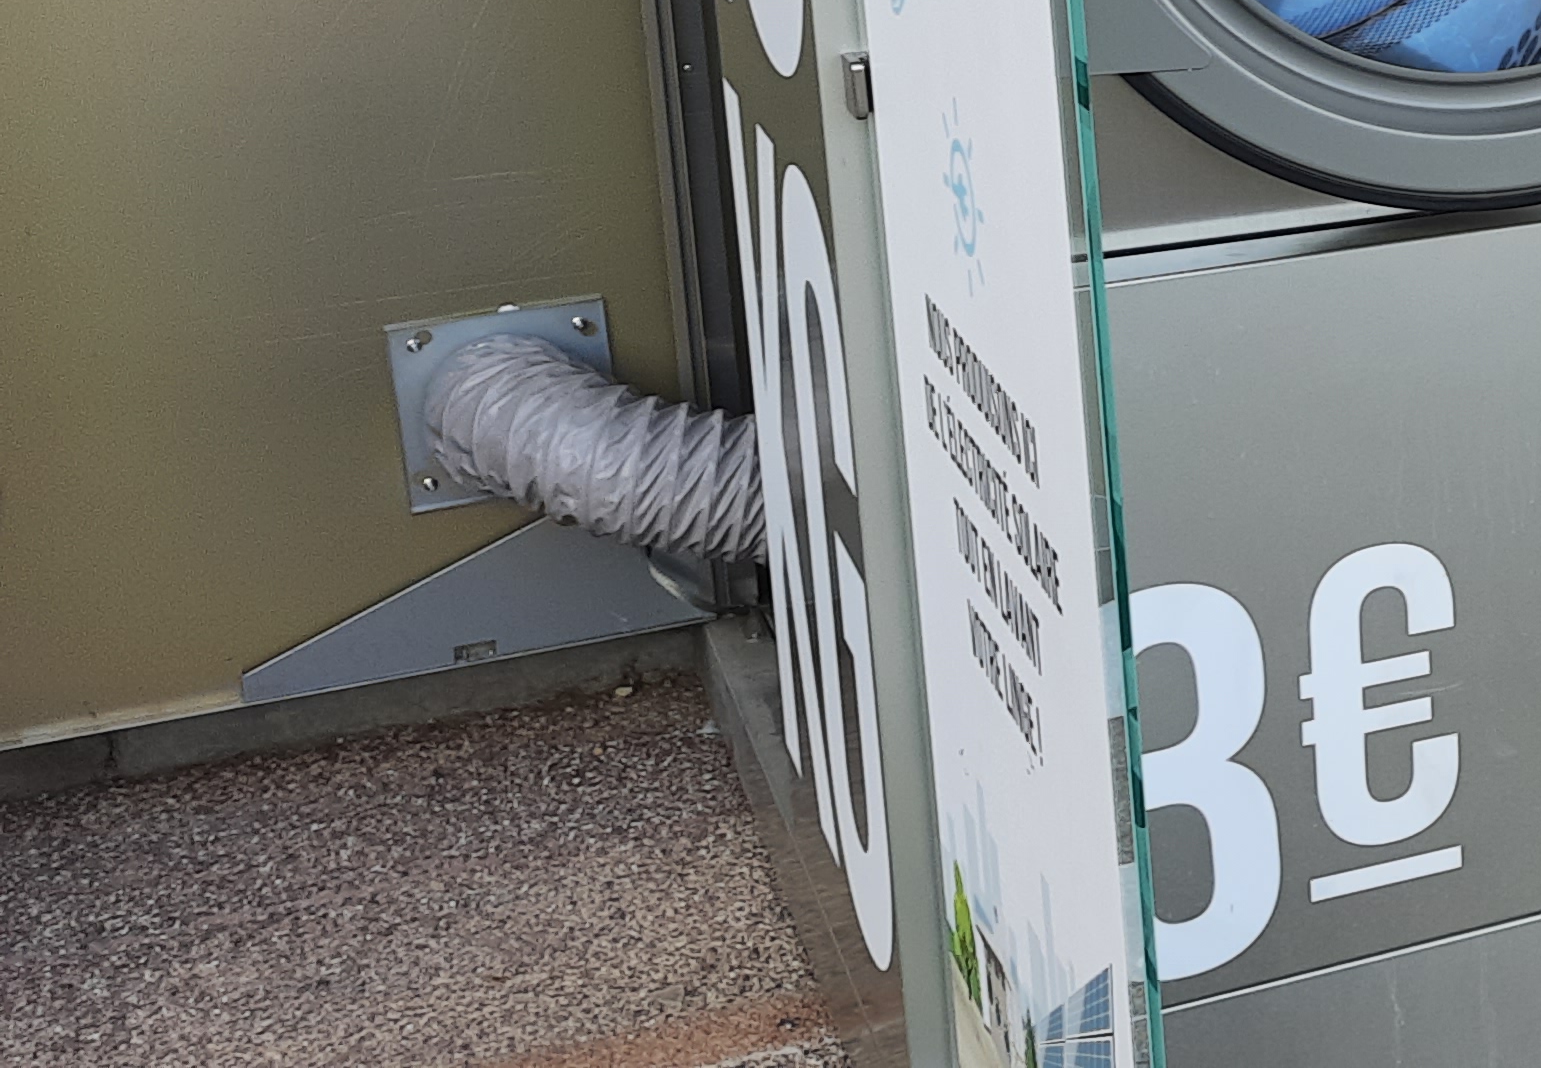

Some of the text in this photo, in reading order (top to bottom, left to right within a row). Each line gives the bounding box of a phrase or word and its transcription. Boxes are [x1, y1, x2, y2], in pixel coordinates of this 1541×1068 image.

[725, 80, 893, 972] KG
[953, 496, 981, 583] TOUT
[998, 560, 1042, 676] LAVANT
[967, 599, 1003, 701] VOTRE
